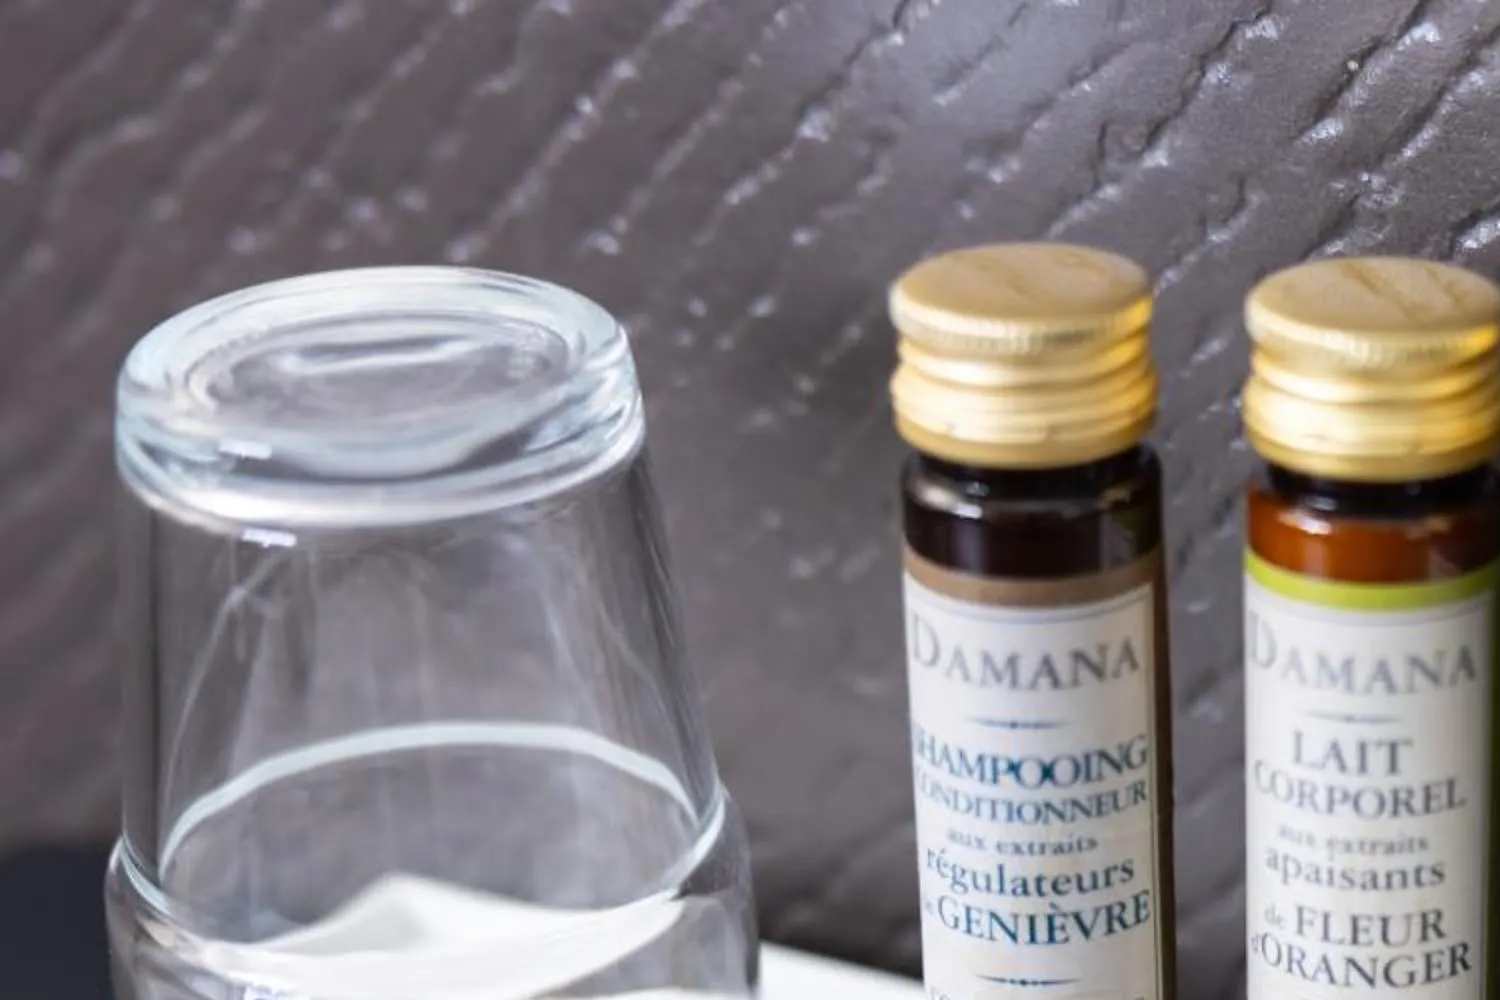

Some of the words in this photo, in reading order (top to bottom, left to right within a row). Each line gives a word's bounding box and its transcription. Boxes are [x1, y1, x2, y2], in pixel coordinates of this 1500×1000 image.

[912, 612, 1140, 691] DAMANA
[1292, 730, 1413, 777] LAIT
[1254, 759, 1467, 819] CORPOREL
[996, 833, 1099, 857] extraits
[1266, 848, 1445, 890] apaisants
[927, 848, 1134, 898] régulateurs
[938, 889, 1151, 946] GENIÈVRE
[1295, 905, 1447, 949] FLEUR
